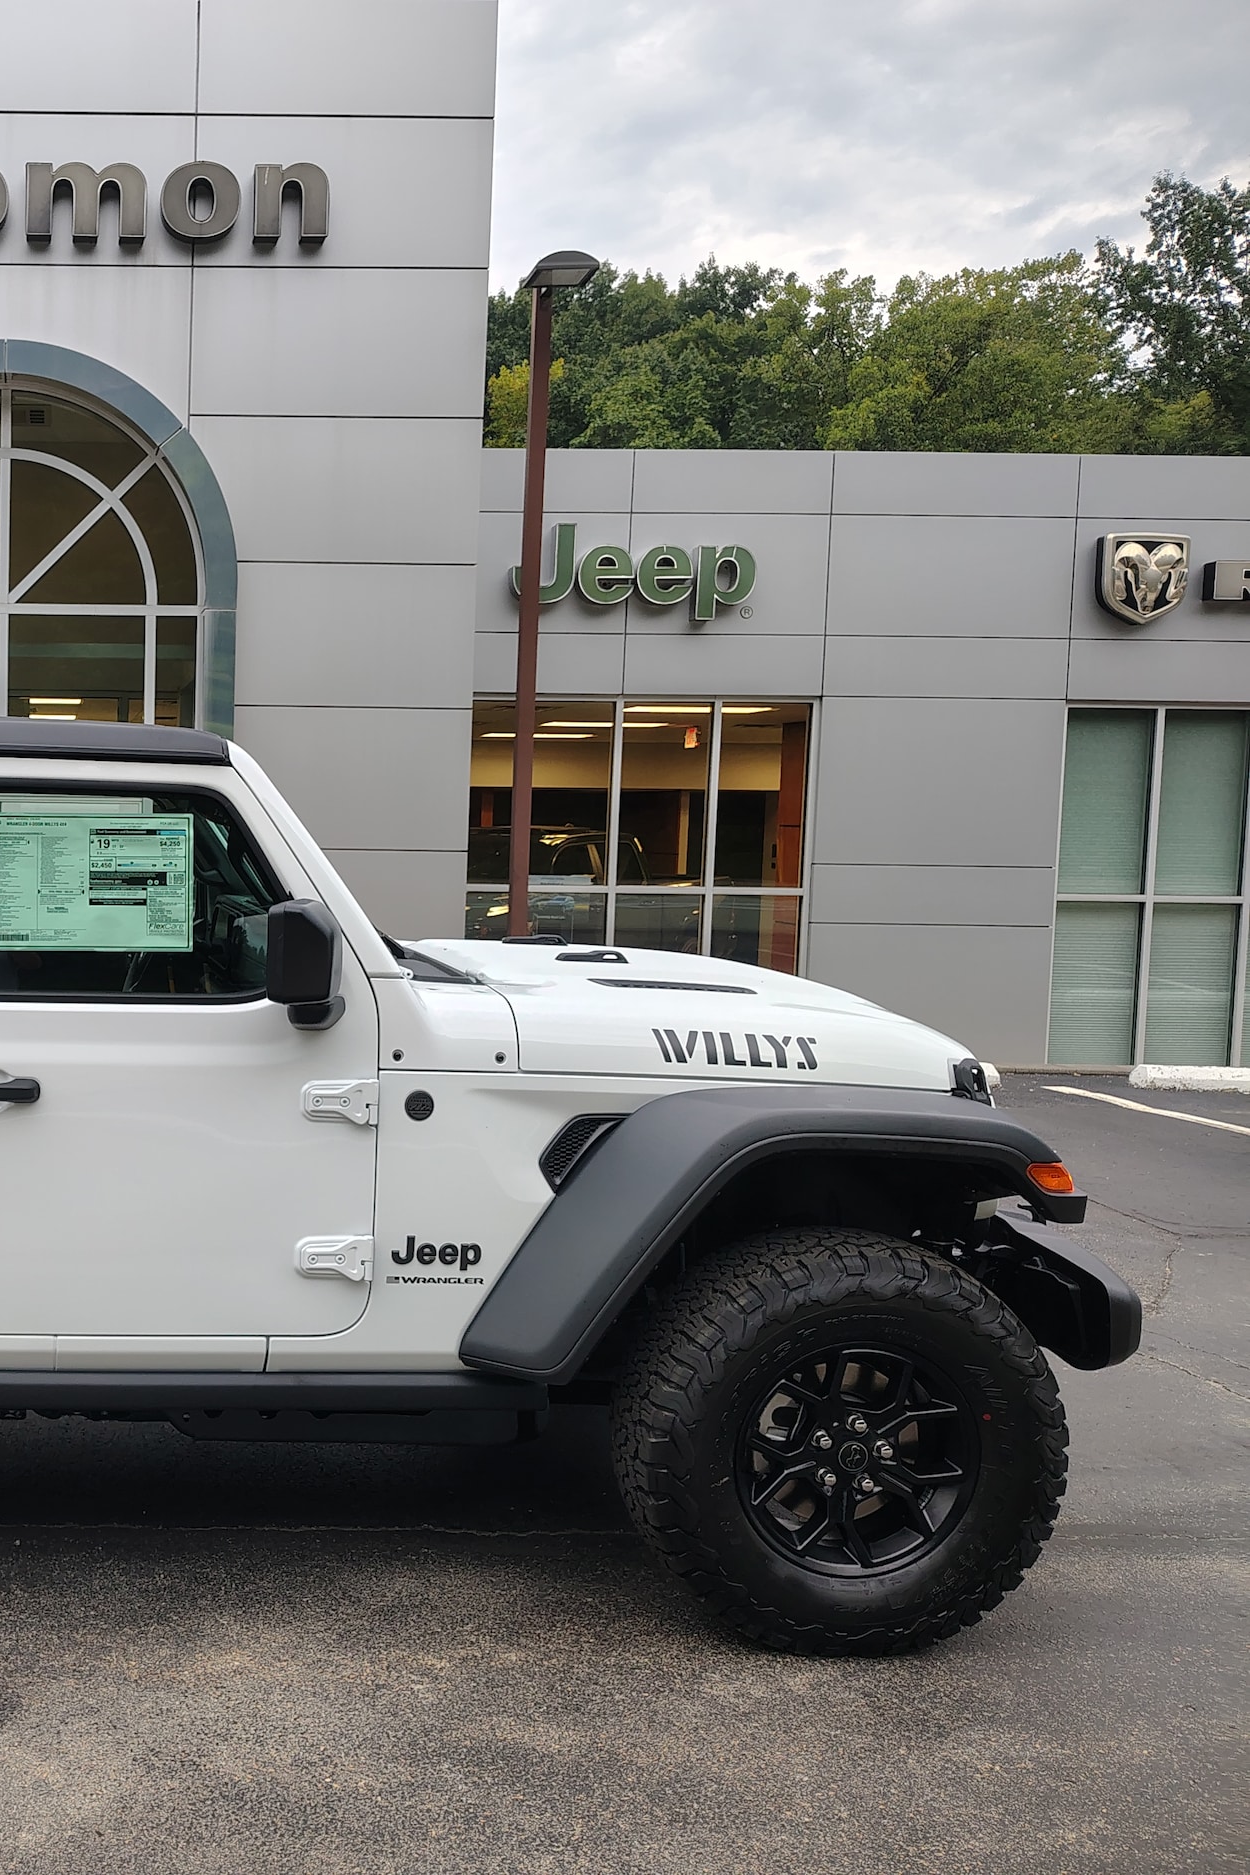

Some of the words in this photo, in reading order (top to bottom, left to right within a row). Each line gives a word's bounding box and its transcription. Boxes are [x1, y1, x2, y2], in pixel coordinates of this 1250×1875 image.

[510, 523, 757, 621] Jeep
[97, 839, 110, 849] 19
[651, 1028, 818, 1071] WILLYS
[391, 1235, 482, 1271] Jeep
[401, 1276, 485, 1285] WRANGLER
